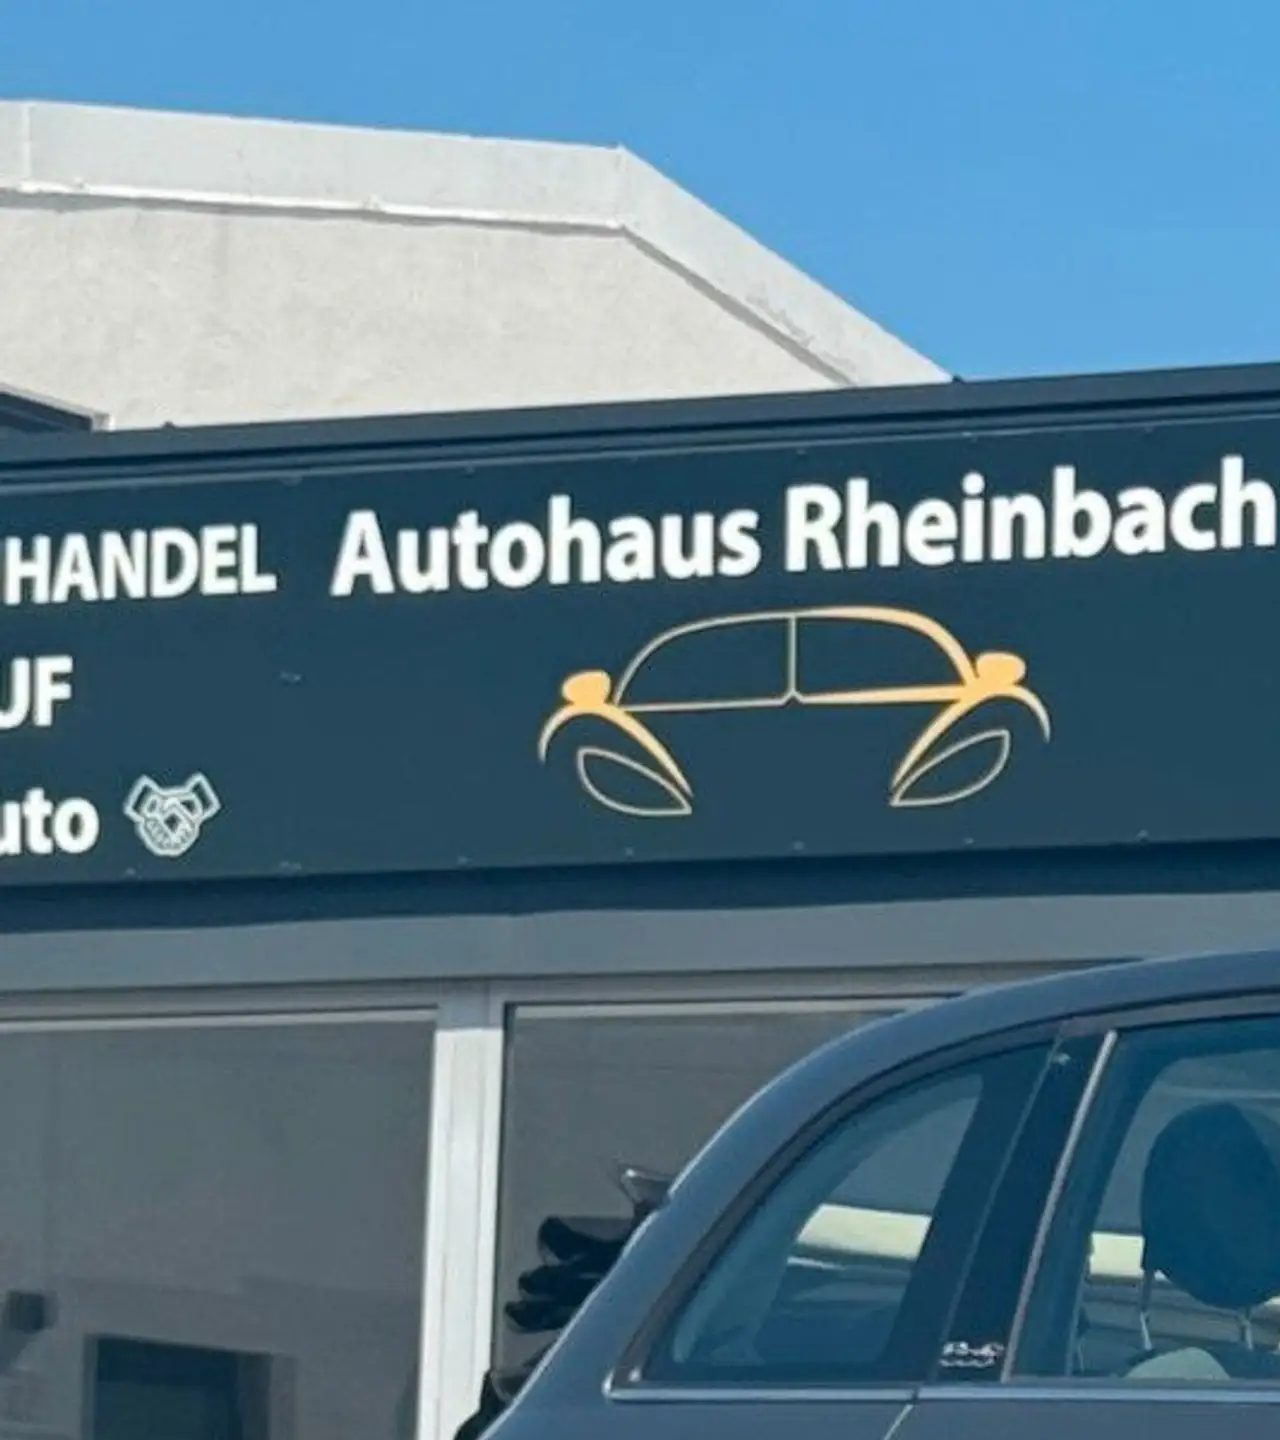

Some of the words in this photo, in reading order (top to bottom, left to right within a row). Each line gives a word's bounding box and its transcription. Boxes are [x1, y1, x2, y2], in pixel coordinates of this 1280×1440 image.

[5, 524, 277, 605] HANDEL
[331, 495, 760, 597] Autohaus
[786, 456, 1276, 572] Rheinbach
